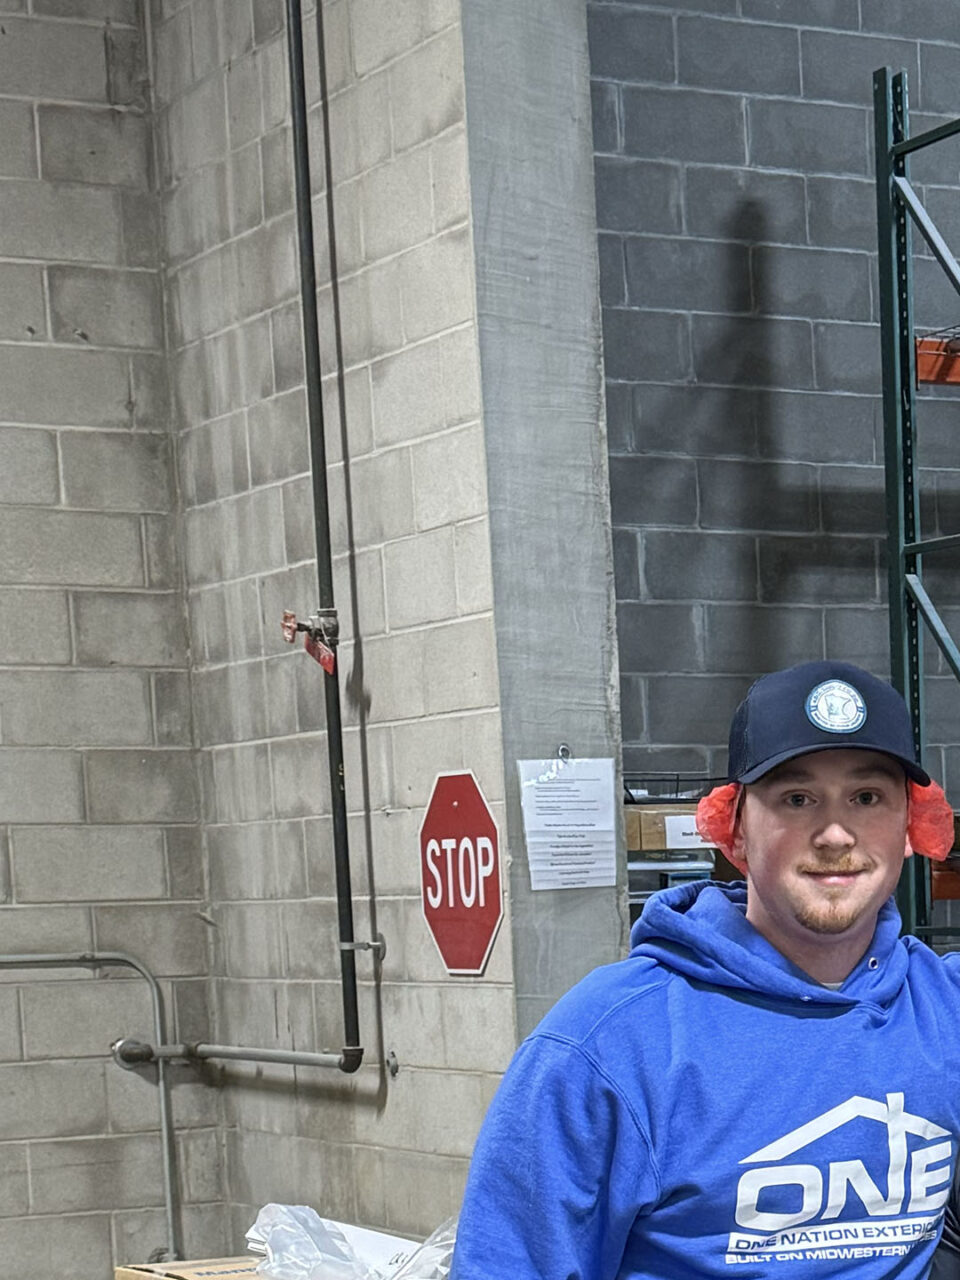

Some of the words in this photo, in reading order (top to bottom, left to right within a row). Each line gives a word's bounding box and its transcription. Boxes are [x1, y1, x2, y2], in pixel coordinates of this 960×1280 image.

[426, 836, 495, 909] STOP
[735, 1108, 952, 1232] ONE
[725, 1253, 772, 1264] BUILT
[776, 1251, 803, 1262] ON
[805, 1245, 910, 1260] MIDWESTERN
[735, 1236, 777, 1251] ONE
[781, 1227, 859, 1245] NATION
